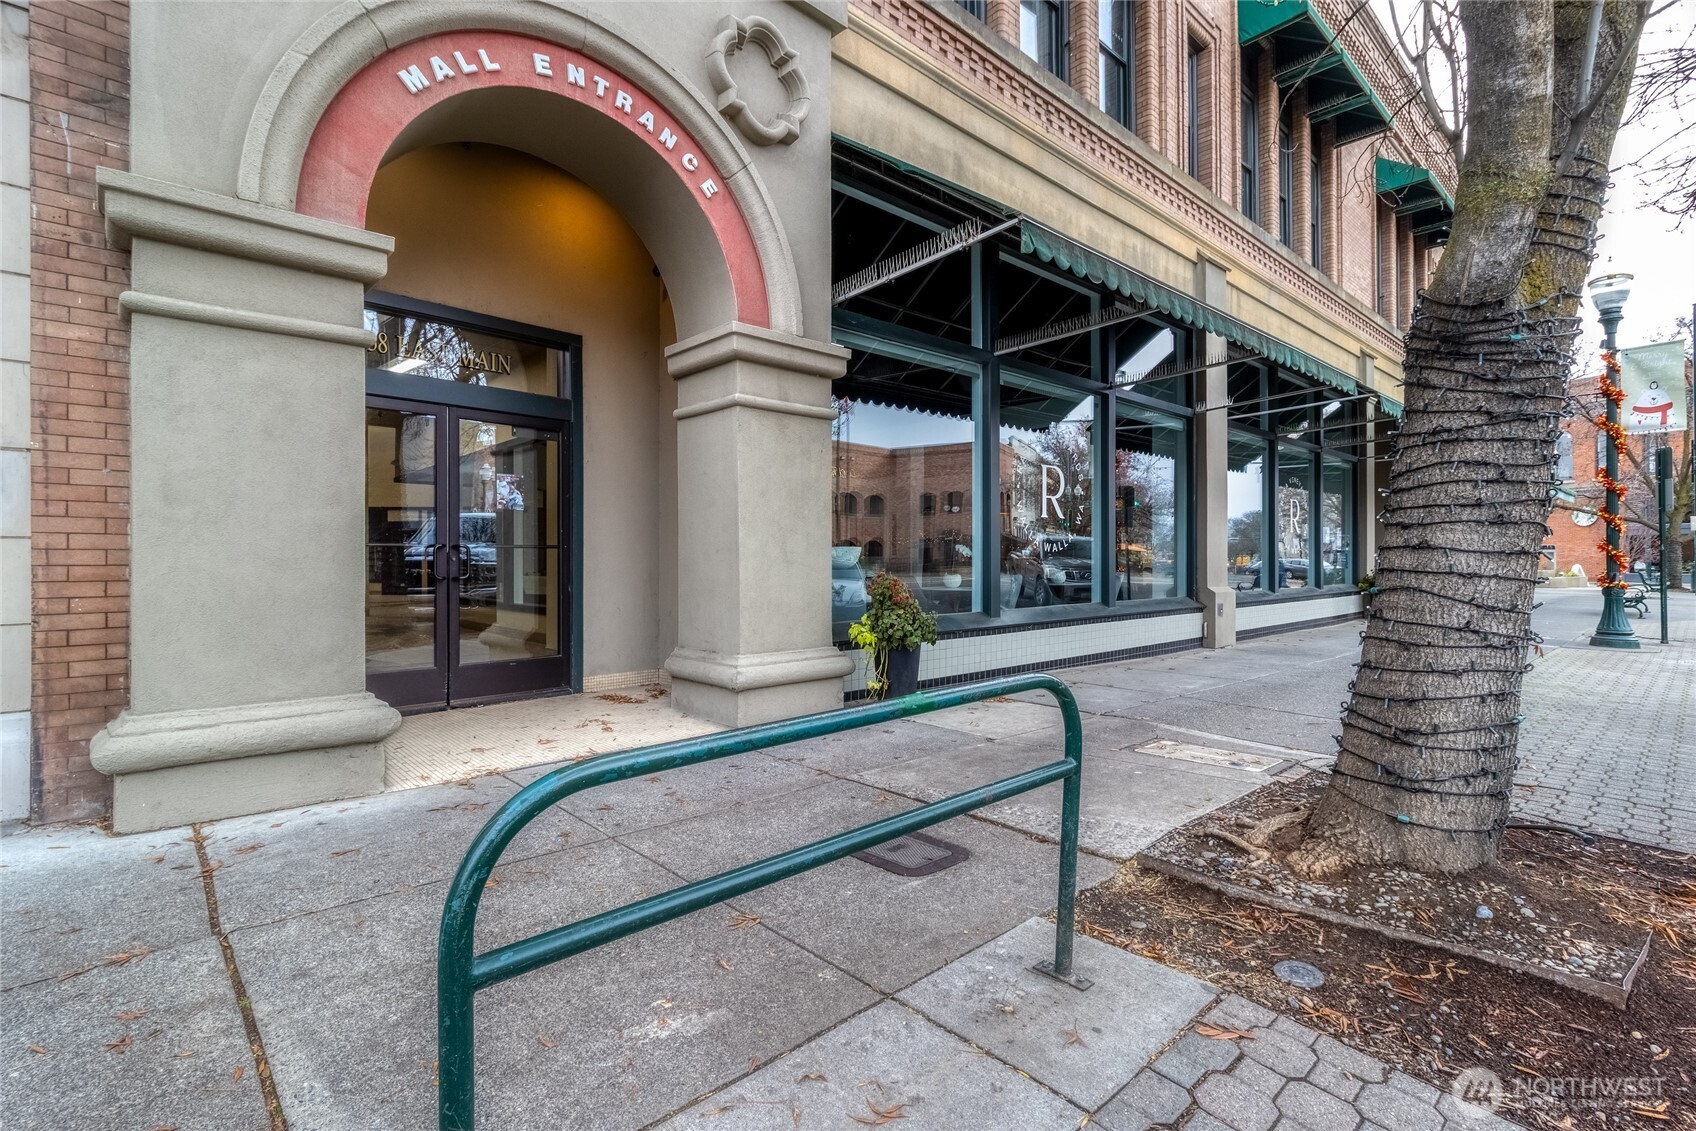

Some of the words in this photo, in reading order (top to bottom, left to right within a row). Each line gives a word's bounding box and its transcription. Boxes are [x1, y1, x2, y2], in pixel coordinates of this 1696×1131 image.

[397, 48, 501, 95] MALL
[532, 52, 719, 199] ENTRANCE
[459, 350, 512, 375] MAIN
[1040, 463, 1065, 519] R
[1290, 498, 1300, 533] R
